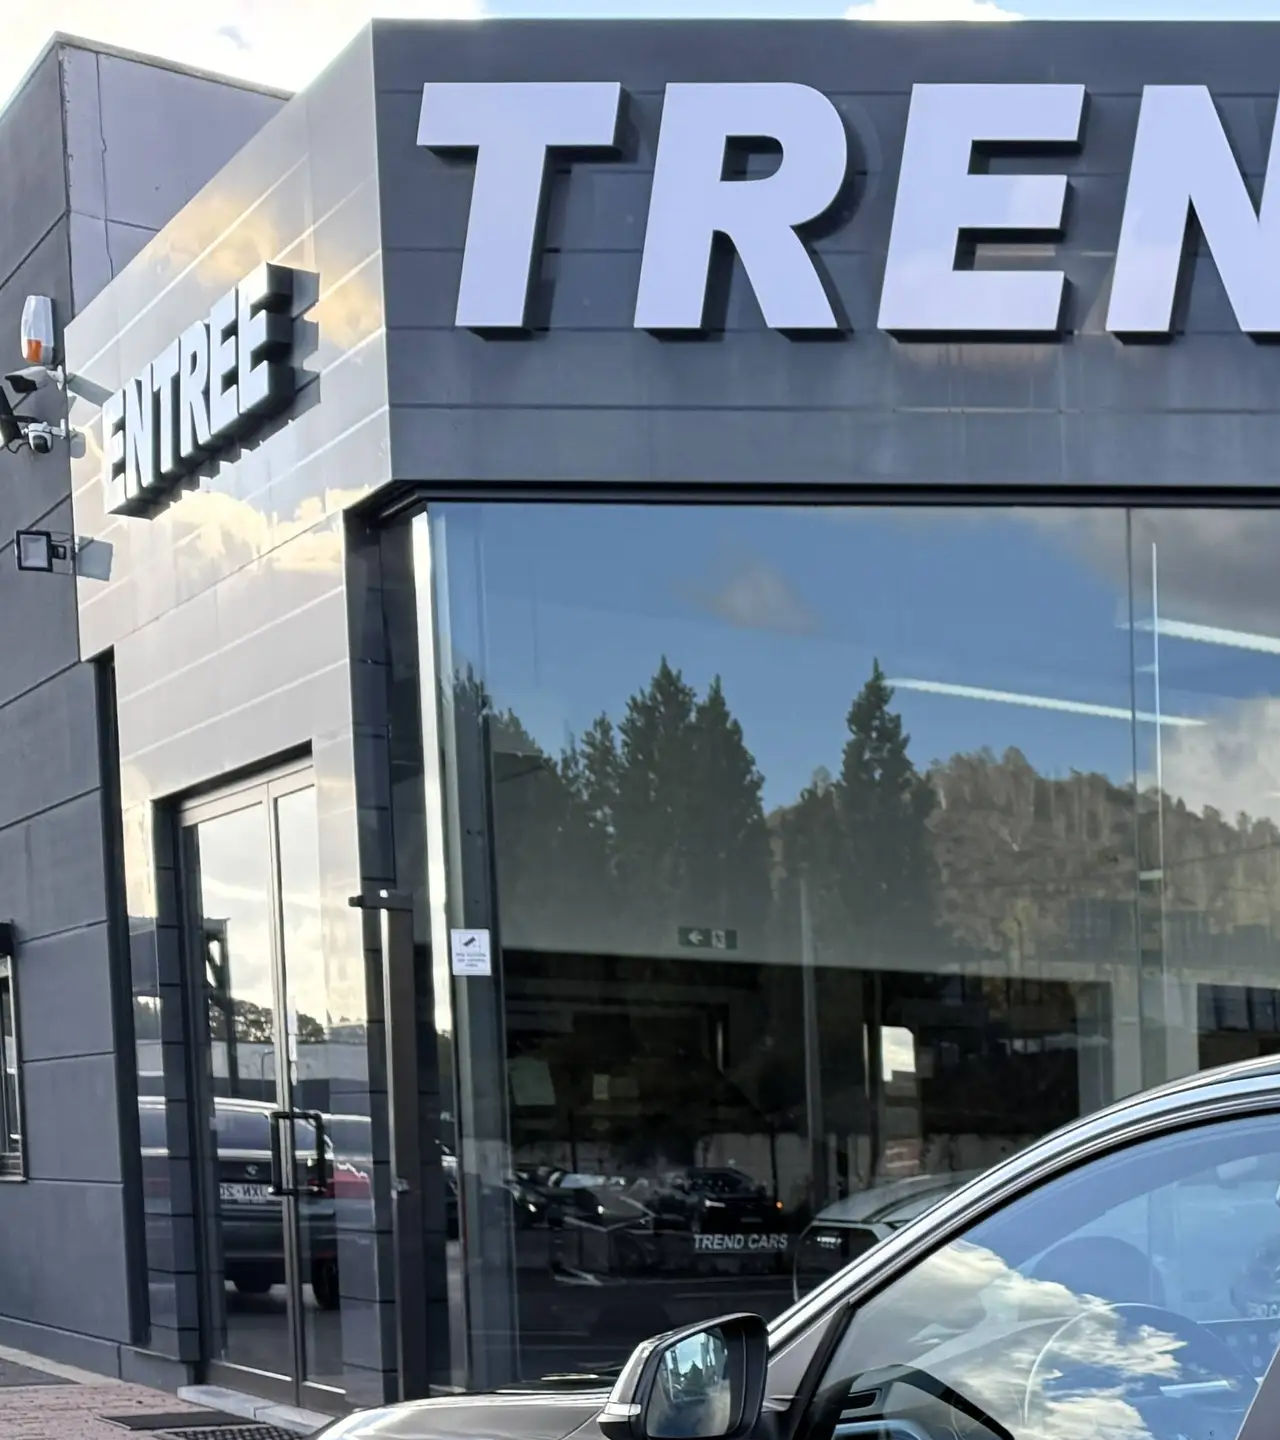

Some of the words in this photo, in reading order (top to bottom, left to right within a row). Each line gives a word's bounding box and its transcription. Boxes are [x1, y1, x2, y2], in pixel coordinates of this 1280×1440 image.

[101, 261, 274, 516] ENTREE
[693, 1233, 745, 1249] TREND
[748, 1233, 788, 1249] CARS
